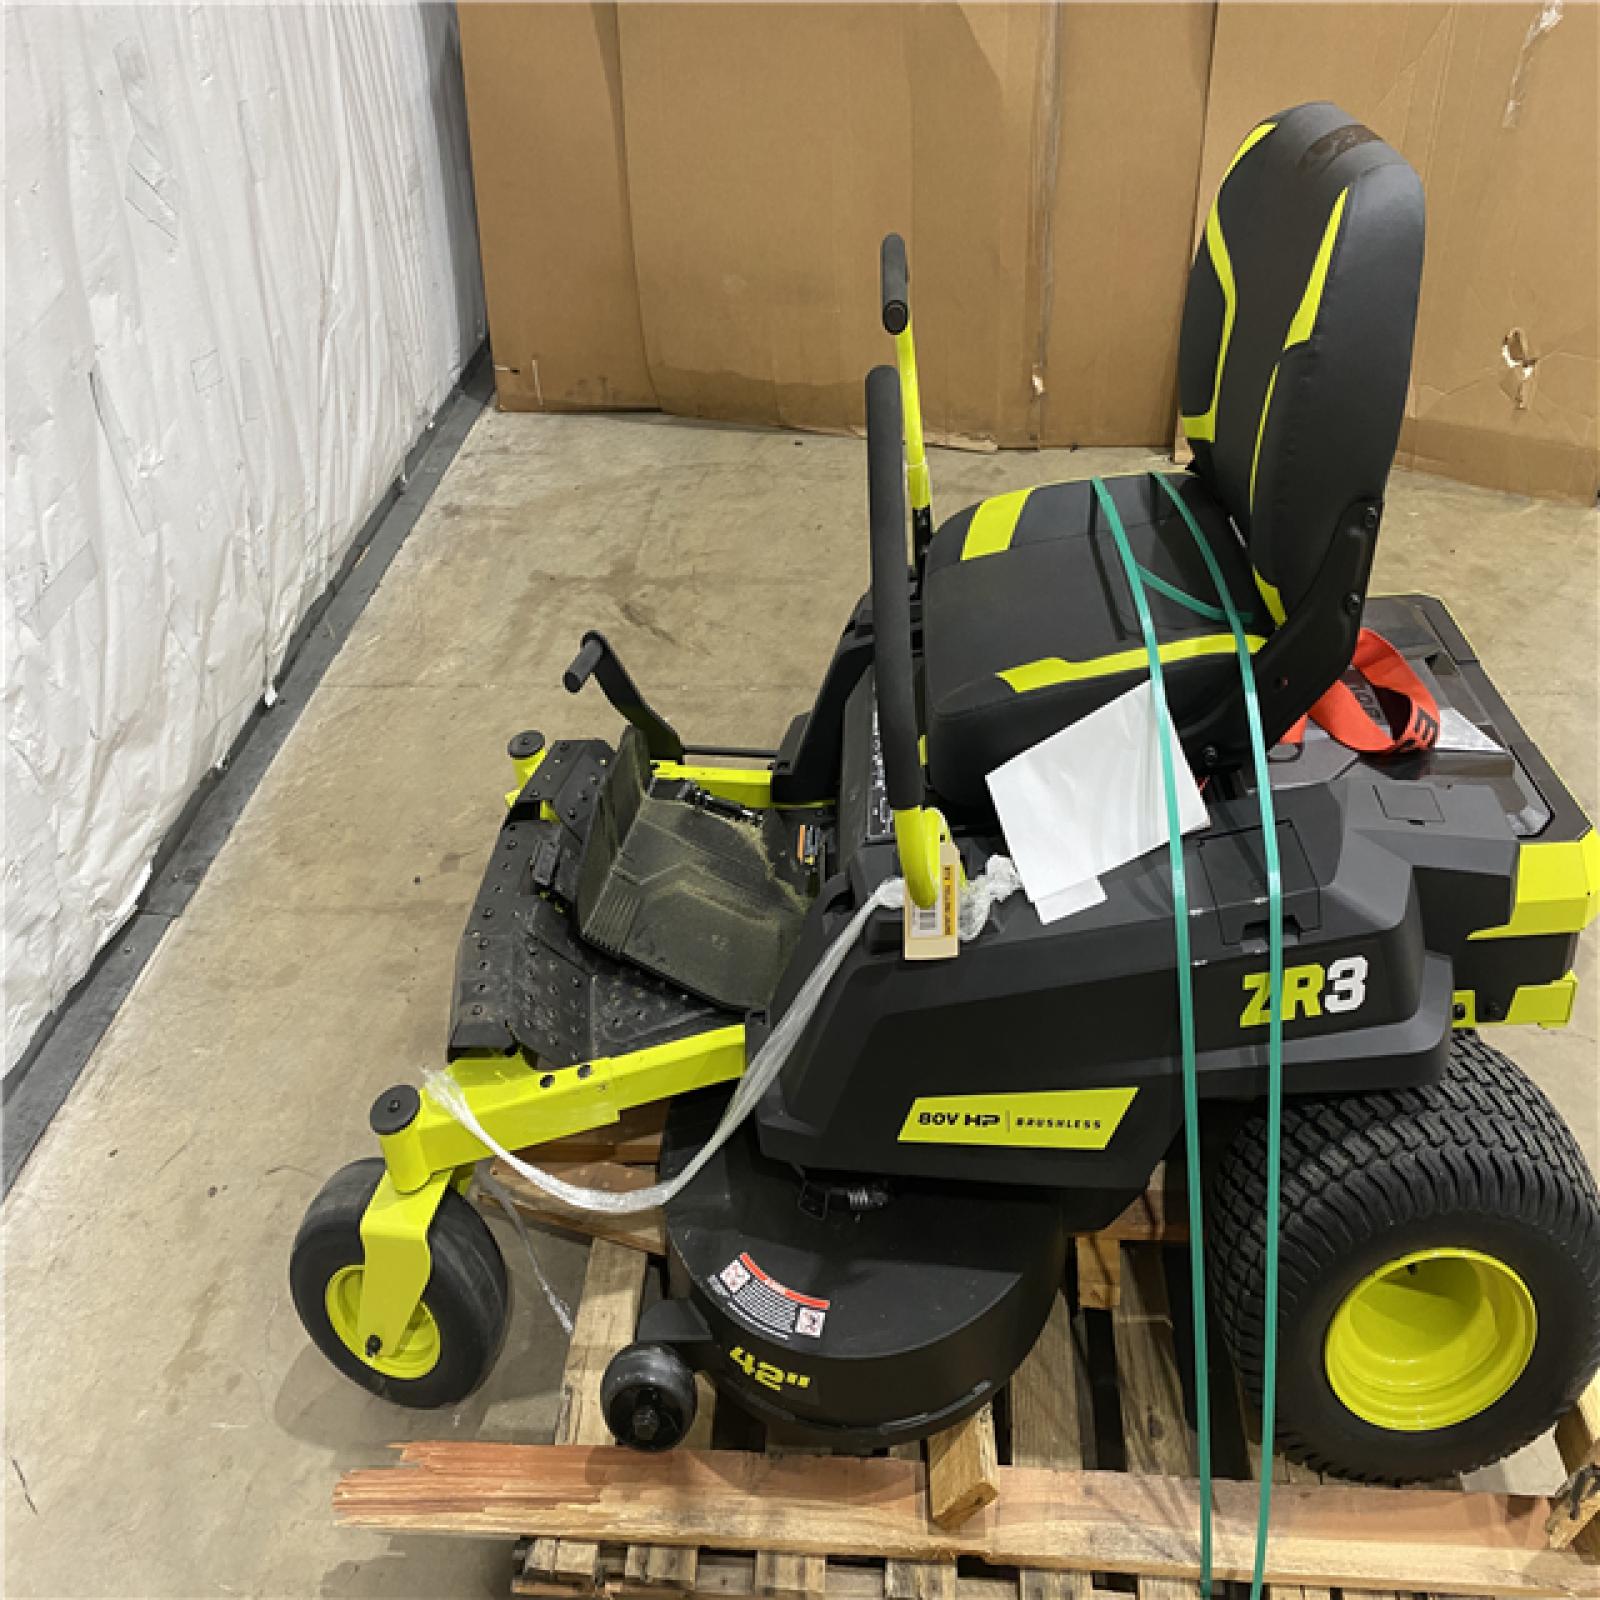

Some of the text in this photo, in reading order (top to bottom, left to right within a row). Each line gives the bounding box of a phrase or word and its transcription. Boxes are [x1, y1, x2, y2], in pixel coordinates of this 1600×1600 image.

[1239, 956, 1368, 1028] ZR3
[917, 1111, 1101, 1130] 80V HP BRUSHLESS
